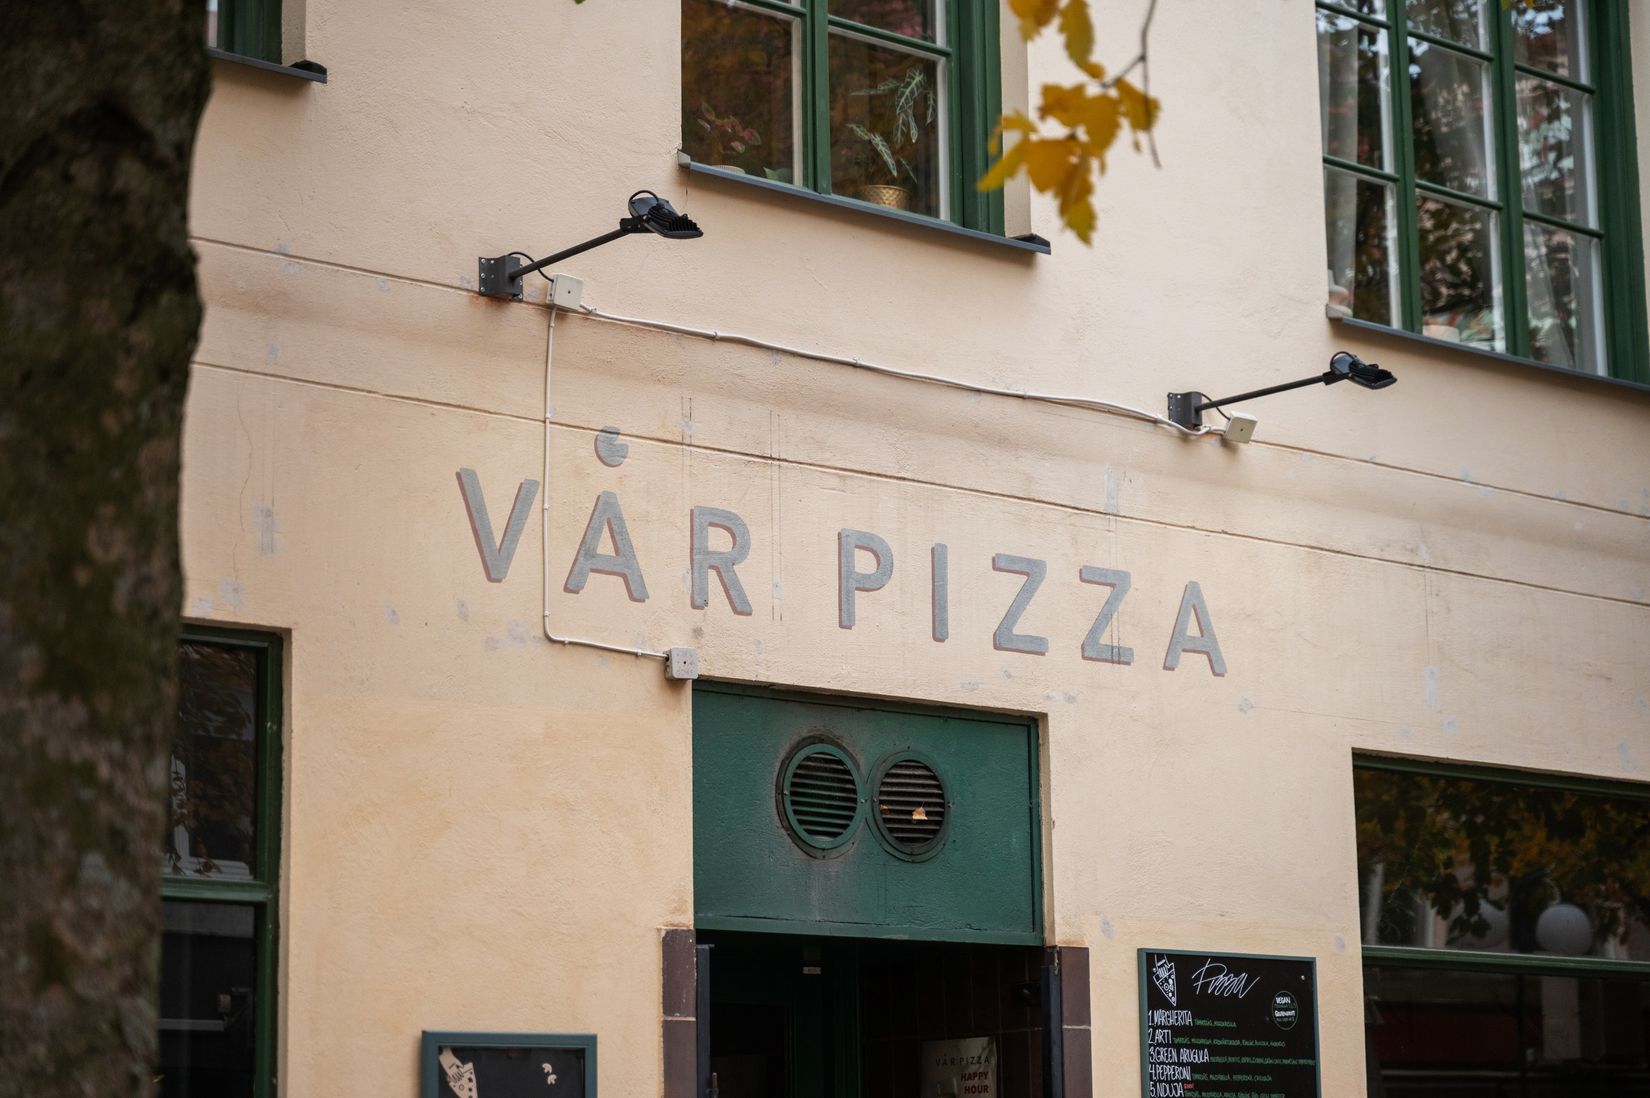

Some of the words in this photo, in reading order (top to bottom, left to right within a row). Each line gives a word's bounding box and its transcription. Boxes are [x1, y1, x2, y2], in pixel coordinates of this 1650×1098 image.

[455, 426, 752, 617] VÅR
[837, 527, 1228, 677] PIZZA
[959, 1055, 990, 1066] PIZZA
[1179, 1048, 1210, 1064] ARUGULA
[960, 1071, 989, 1082] HAPPY
[964, 1084, 989, 1095] HOUR
